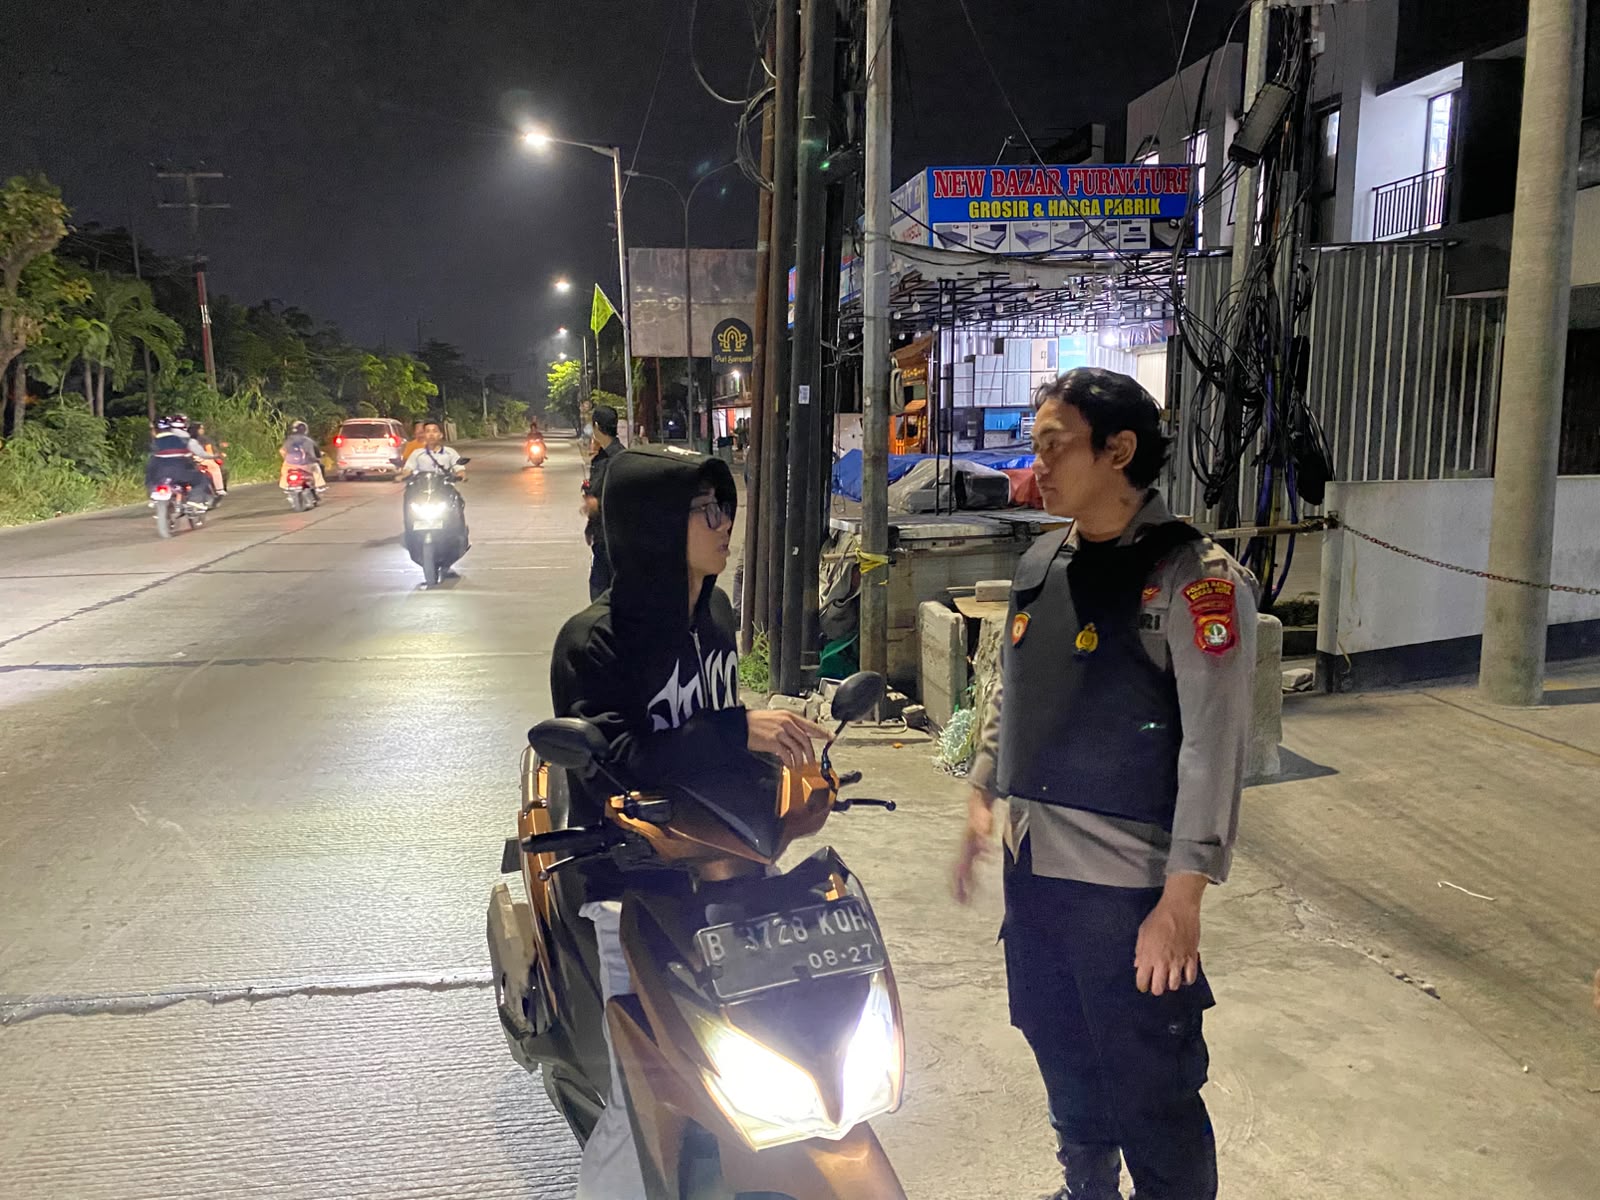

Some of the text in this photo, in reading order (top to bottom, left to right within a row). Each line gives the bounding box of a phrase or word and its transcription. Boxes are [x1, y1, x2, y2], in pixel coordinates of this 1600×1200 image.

[933, 169, 986, 198] NEW
[990, 168, 1063, 197] BAZAR
[968, 198, 1161, 218] GROSIR & HARGA PABRIK
[705, 932, 726, 961] B
